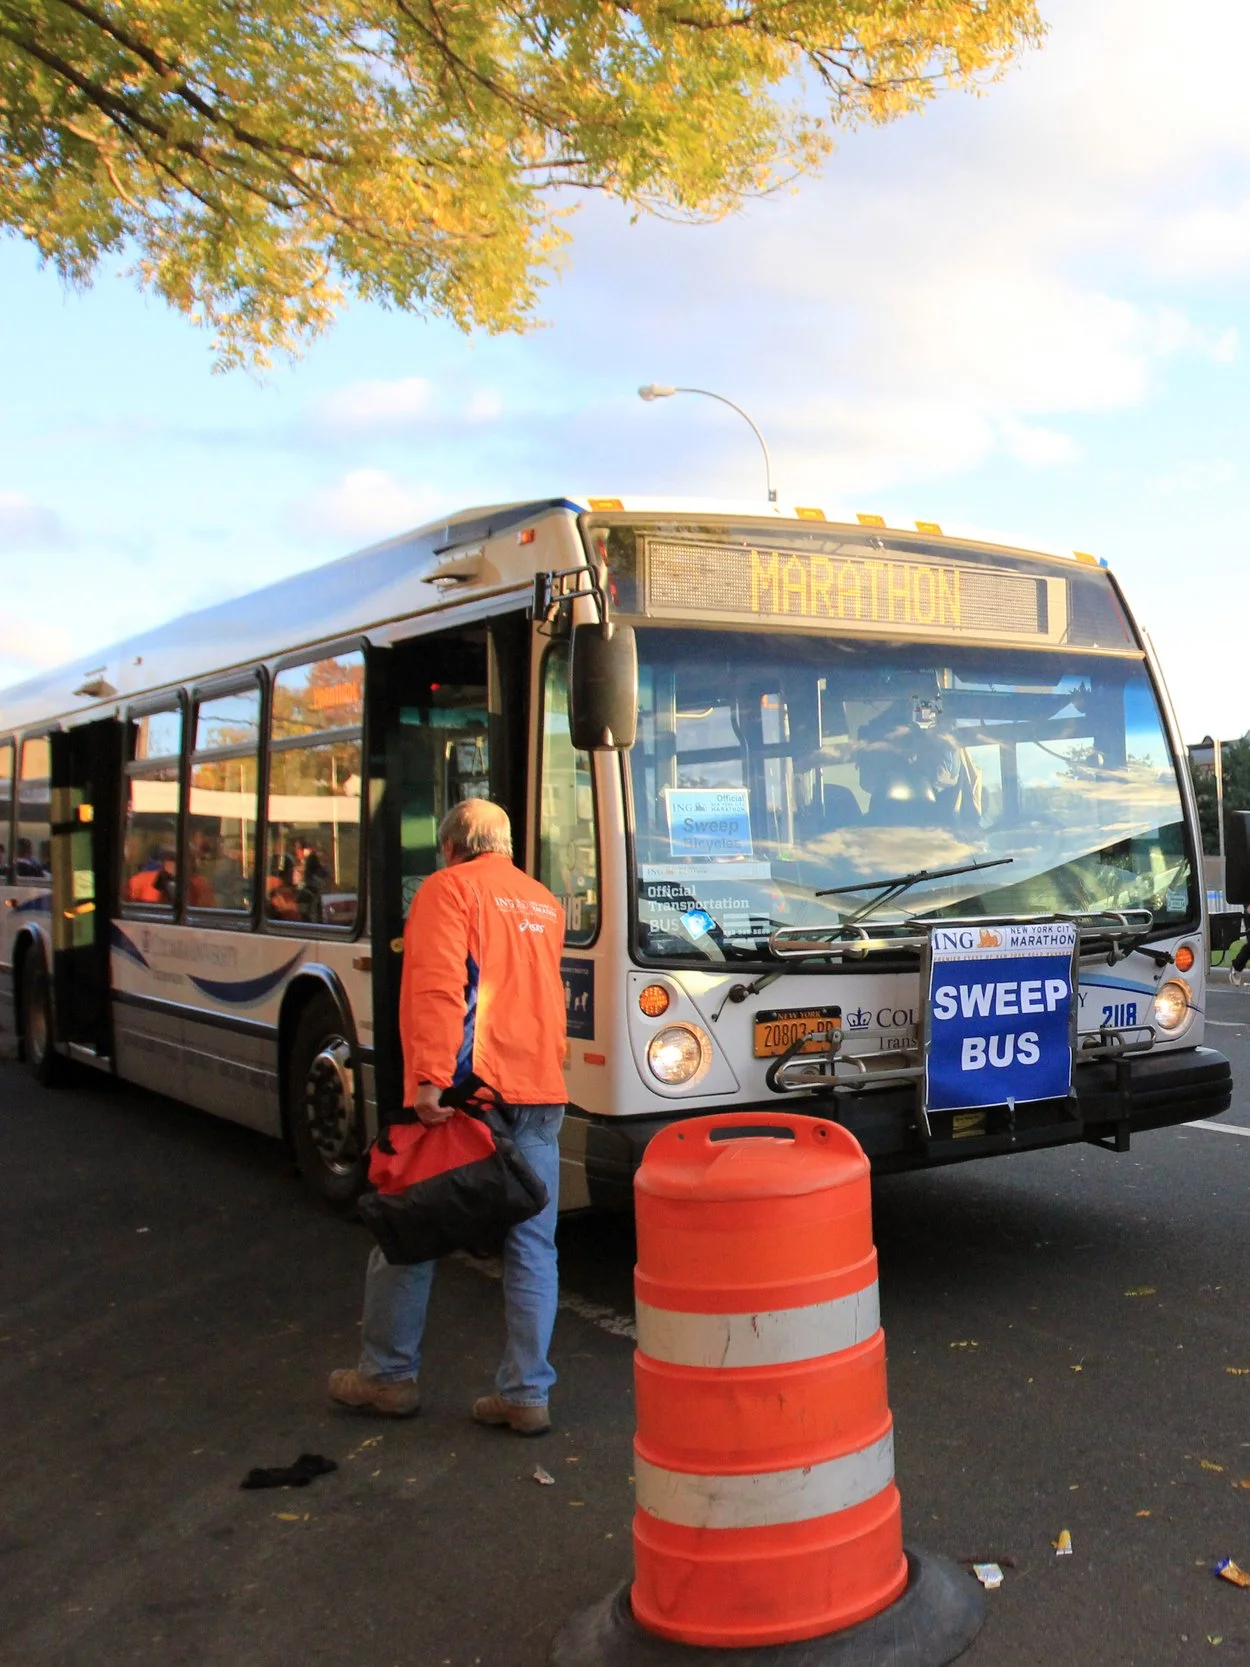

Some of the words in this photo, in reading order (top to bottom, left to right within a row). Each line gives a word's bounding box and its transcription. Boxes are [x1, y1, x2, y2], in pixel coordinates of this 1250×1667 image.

[751, 550, 961, 626] MARATHON
[716, 794, 744, 802] Official
[683, 818, 739, 835] Sweep
[648, 885, 696, 898] Official
[648, 898, 750, 912] Transportation
[1031, 925, 1053, 934] YORK
[1056, 925, 1070, 933] CIT
[934, 931, 974, 950] ING
[1010, 934, 1075, 947] MARATHON
[933, 979, 1068, 1020] SWEEP
[777, 1012, 797, 1020] NEW
[800, 1010, 820, 1018] YORK
[1102, 1002, 1137, 1027] 2118
[879, 1036, 917, 1050] Trans
[961, 1031, 1041, 1071] BUS
